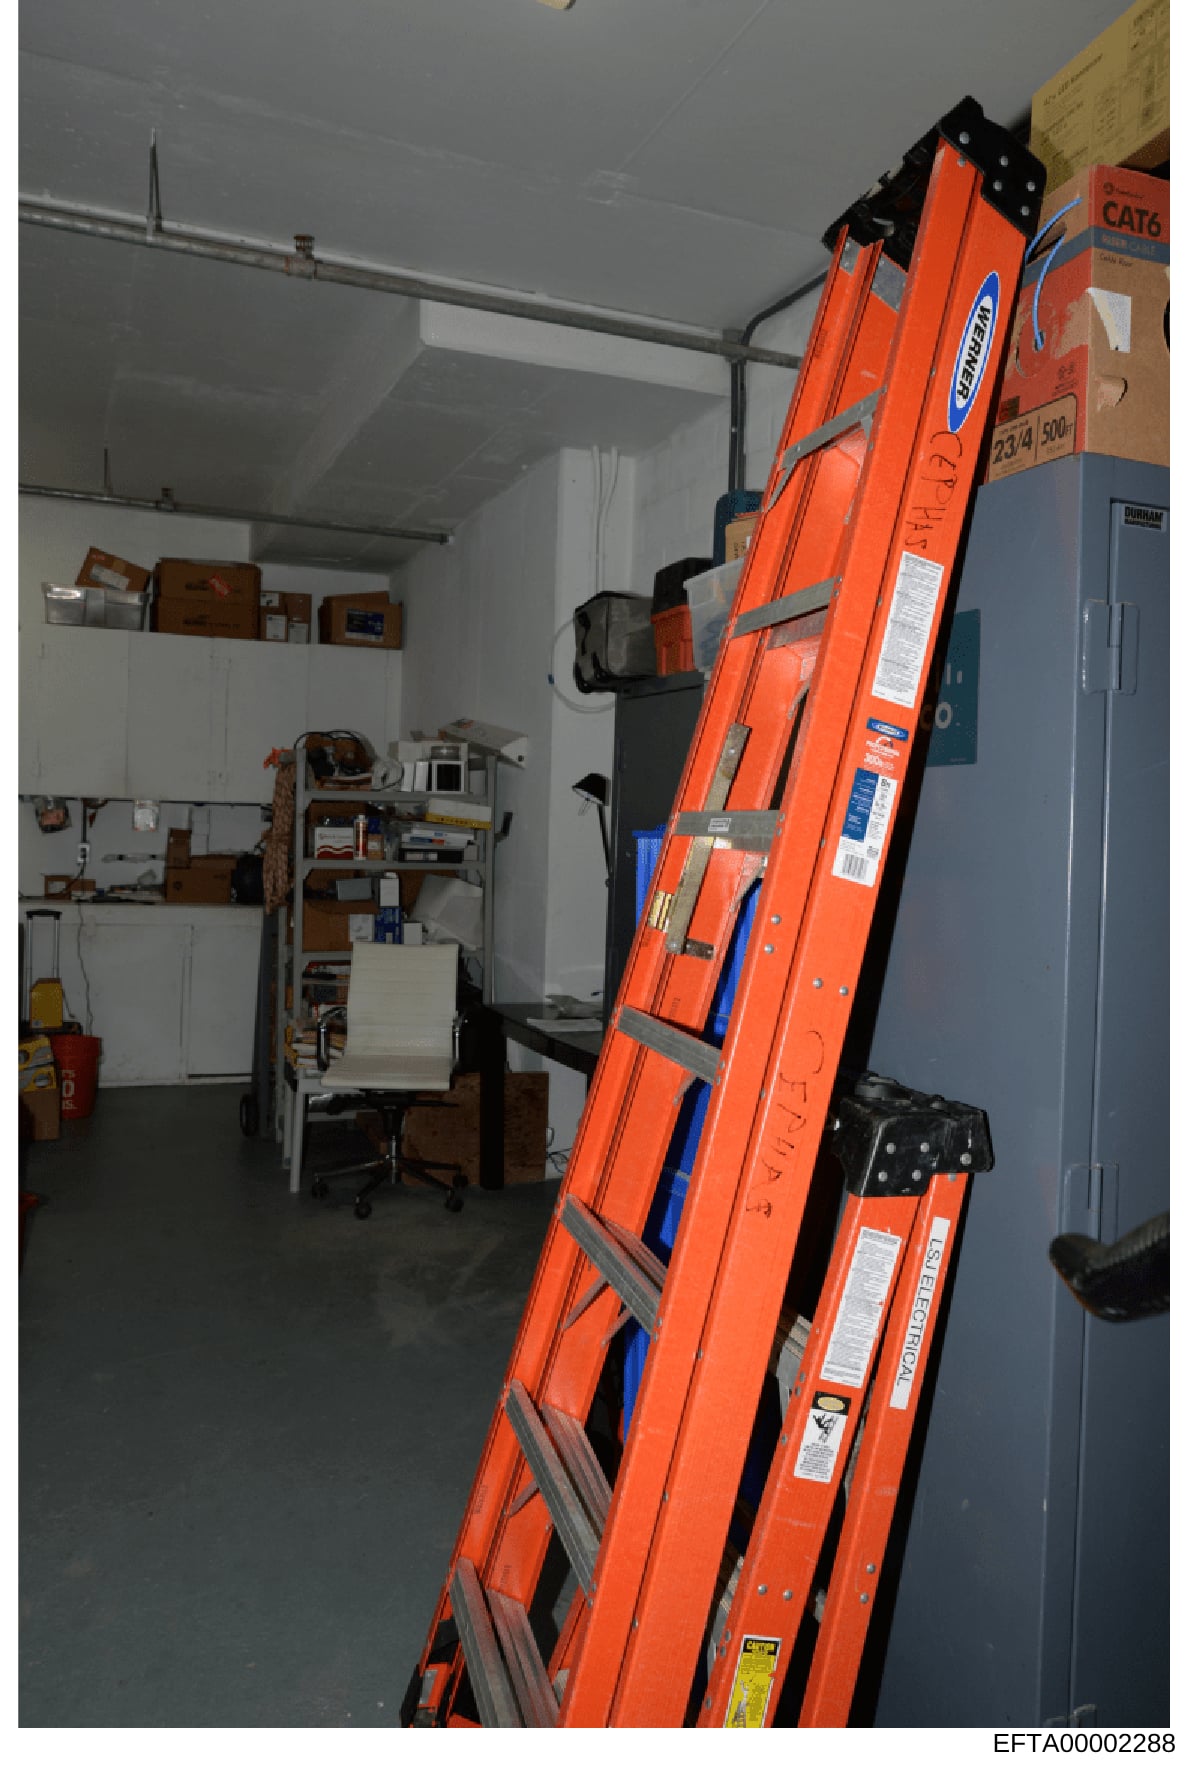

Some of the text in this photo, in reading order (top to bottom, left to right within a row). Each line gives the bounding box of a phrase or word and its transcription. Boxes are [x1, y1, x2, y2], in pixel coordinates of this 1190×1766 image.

[1103, 200, 1162, 238] CAT6
[956, 305, 992, 401] WERNER
[992, 426, 1033, 465] 23/4
[1124, 506, 1164, 522] DURHAM
[896, 1237, 943, 1387] LSJ ELECTRICAL
